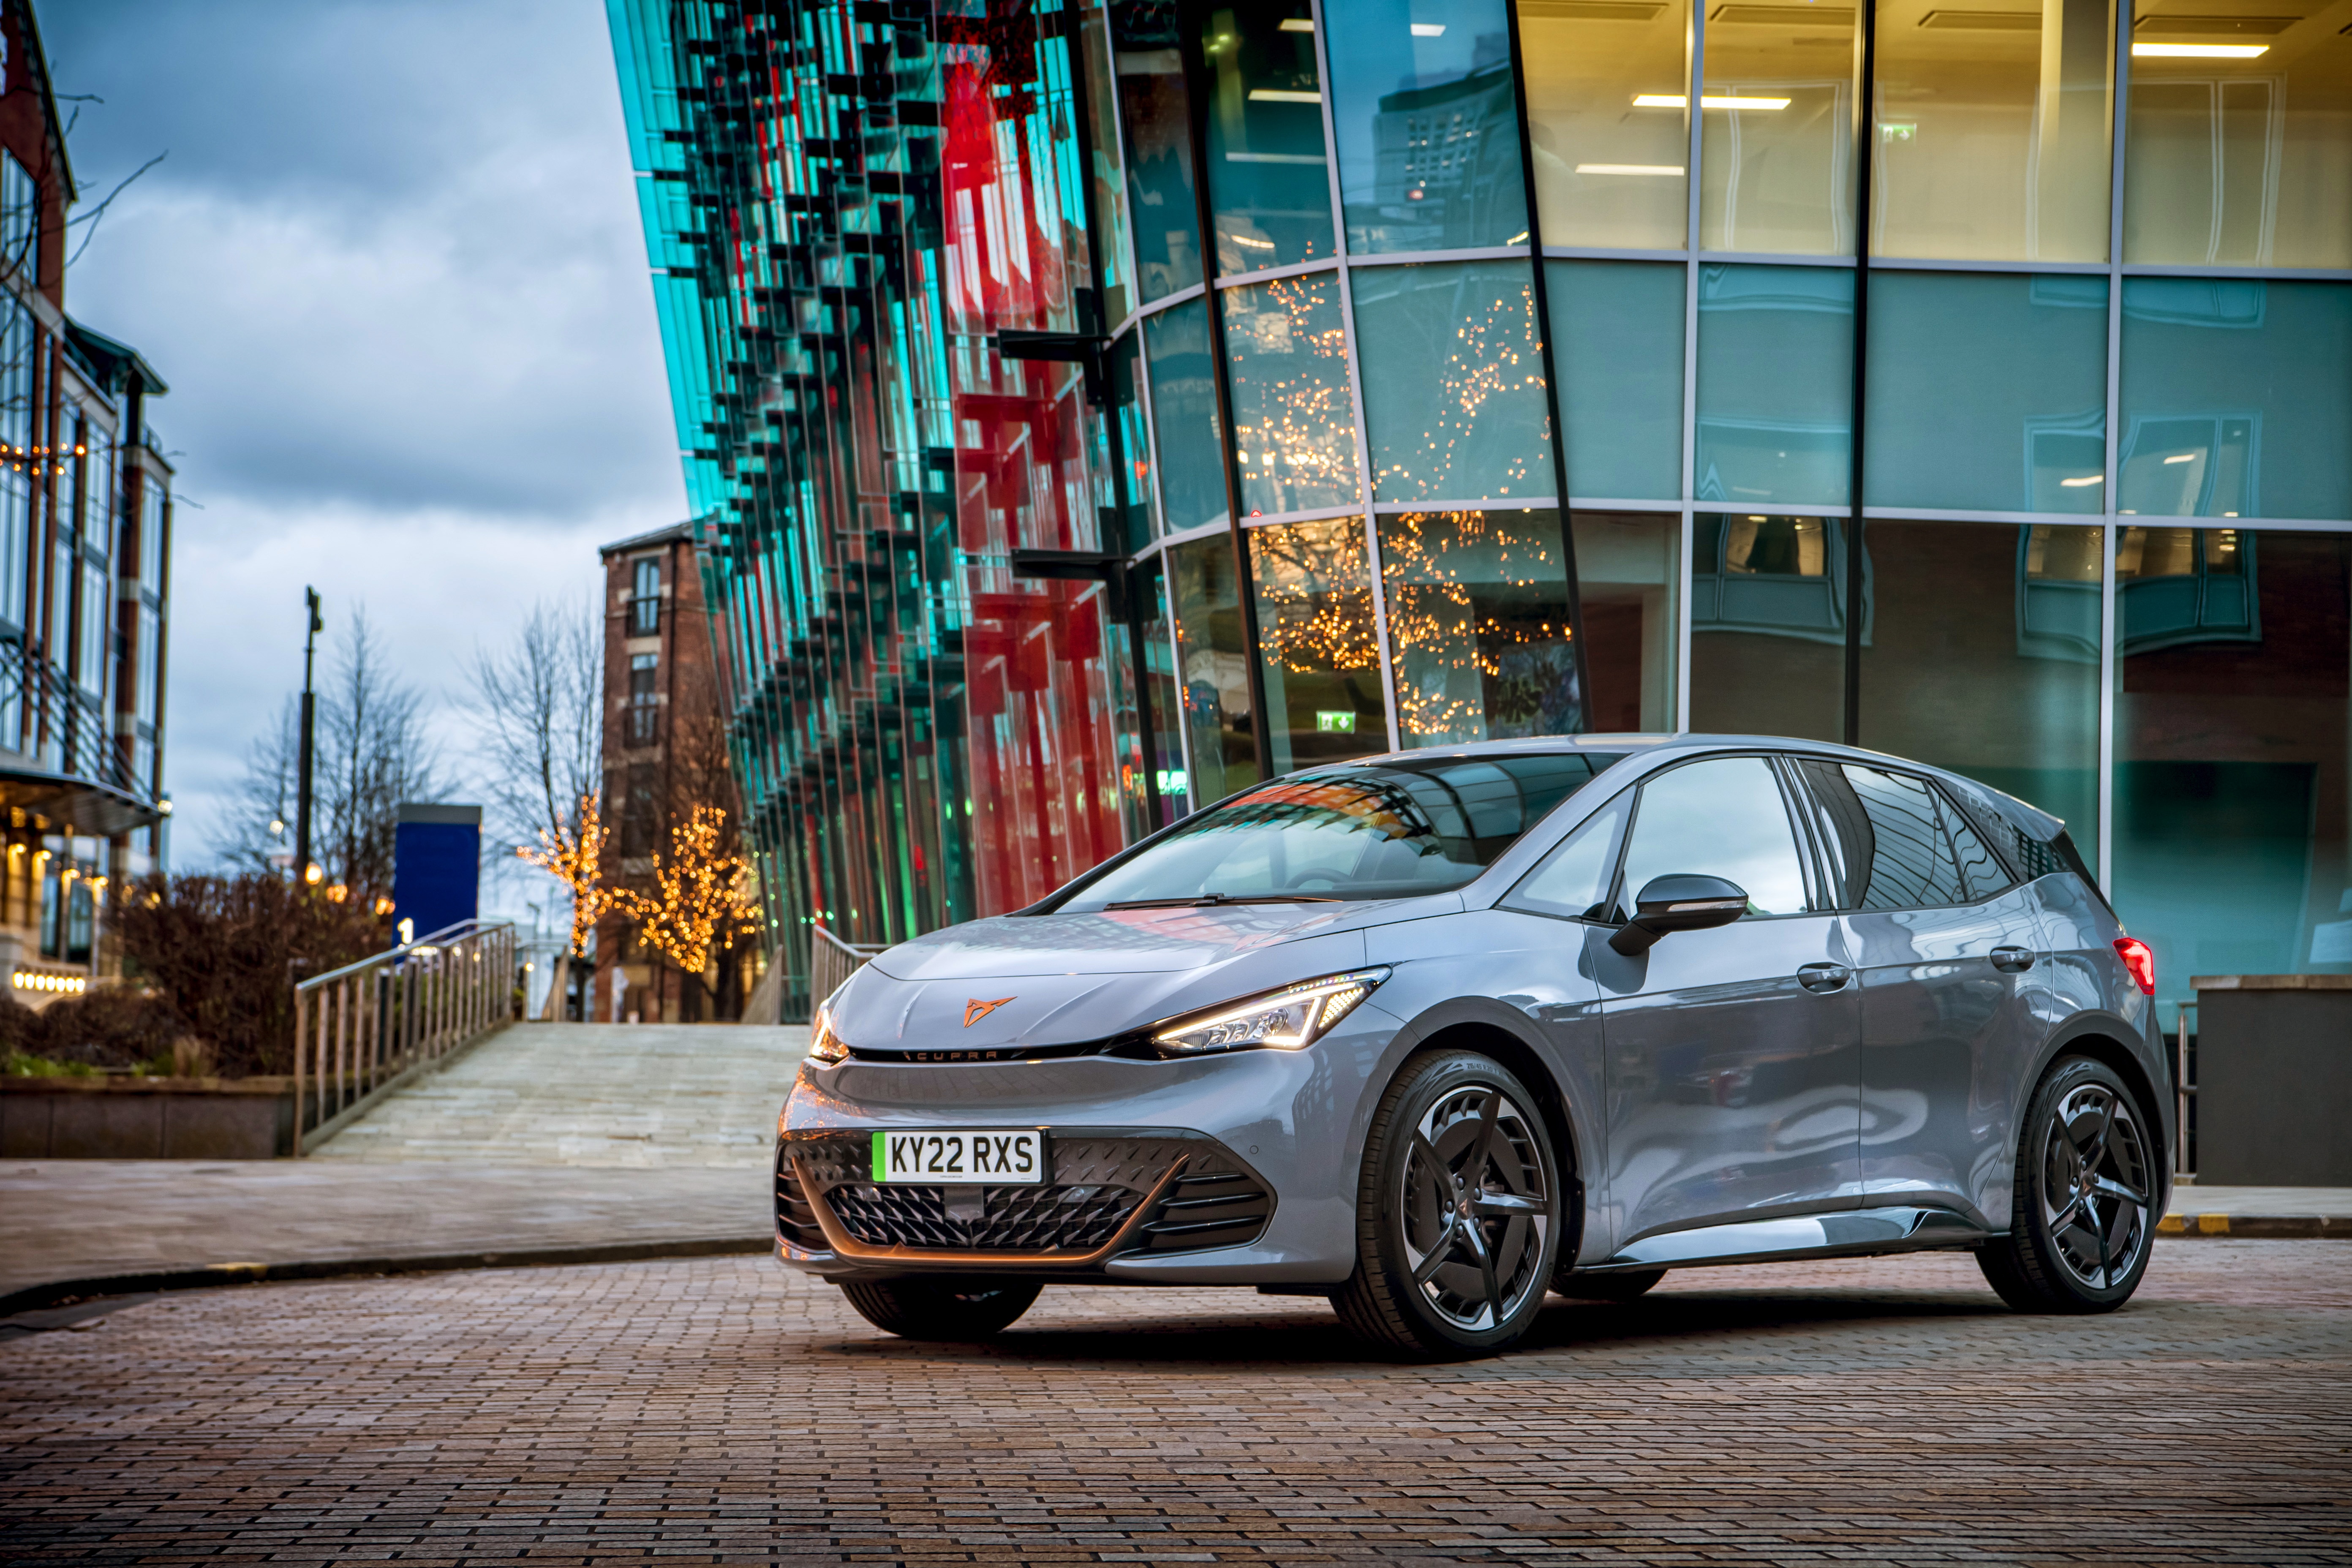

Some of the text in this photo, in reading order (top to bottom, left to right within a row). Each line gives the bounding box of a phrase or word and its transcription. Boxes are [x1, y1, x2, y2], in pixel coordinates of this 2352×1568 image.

[917, 1052, 997, 1060] CUPRA
[892, 1137, 1033, 1173] KY22 RXS
